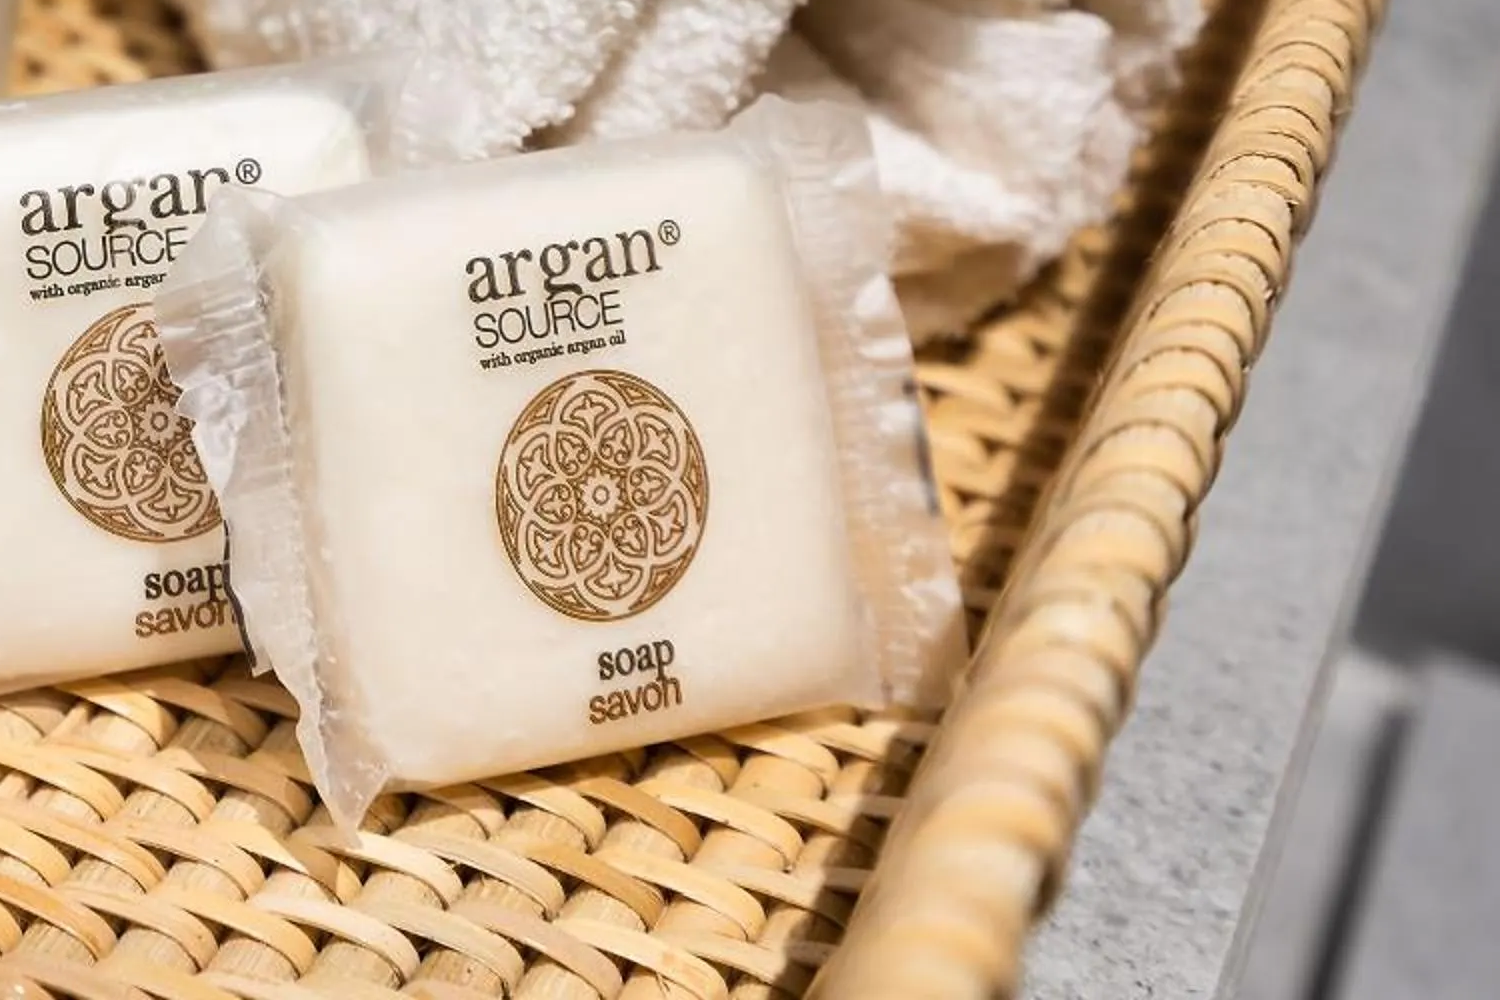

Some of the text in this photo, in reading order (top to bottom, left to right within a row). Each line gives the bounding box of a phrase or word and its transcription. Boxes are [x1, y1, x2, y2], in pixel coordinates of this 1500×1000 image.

[26, 226, 189, 280] SOURCE
[465, 219, 682, 303] argan®
[30, 283, 64, 300] with
[67, 274, 121, 296] organic
[473, 289, 624, 349] SOURCE
[479, 329, 627, 370] with organic argan oil
[143, 563, 224, 602] soap
[597, 639, 675, 682] soap
[589, 677, 683, 725] savon
